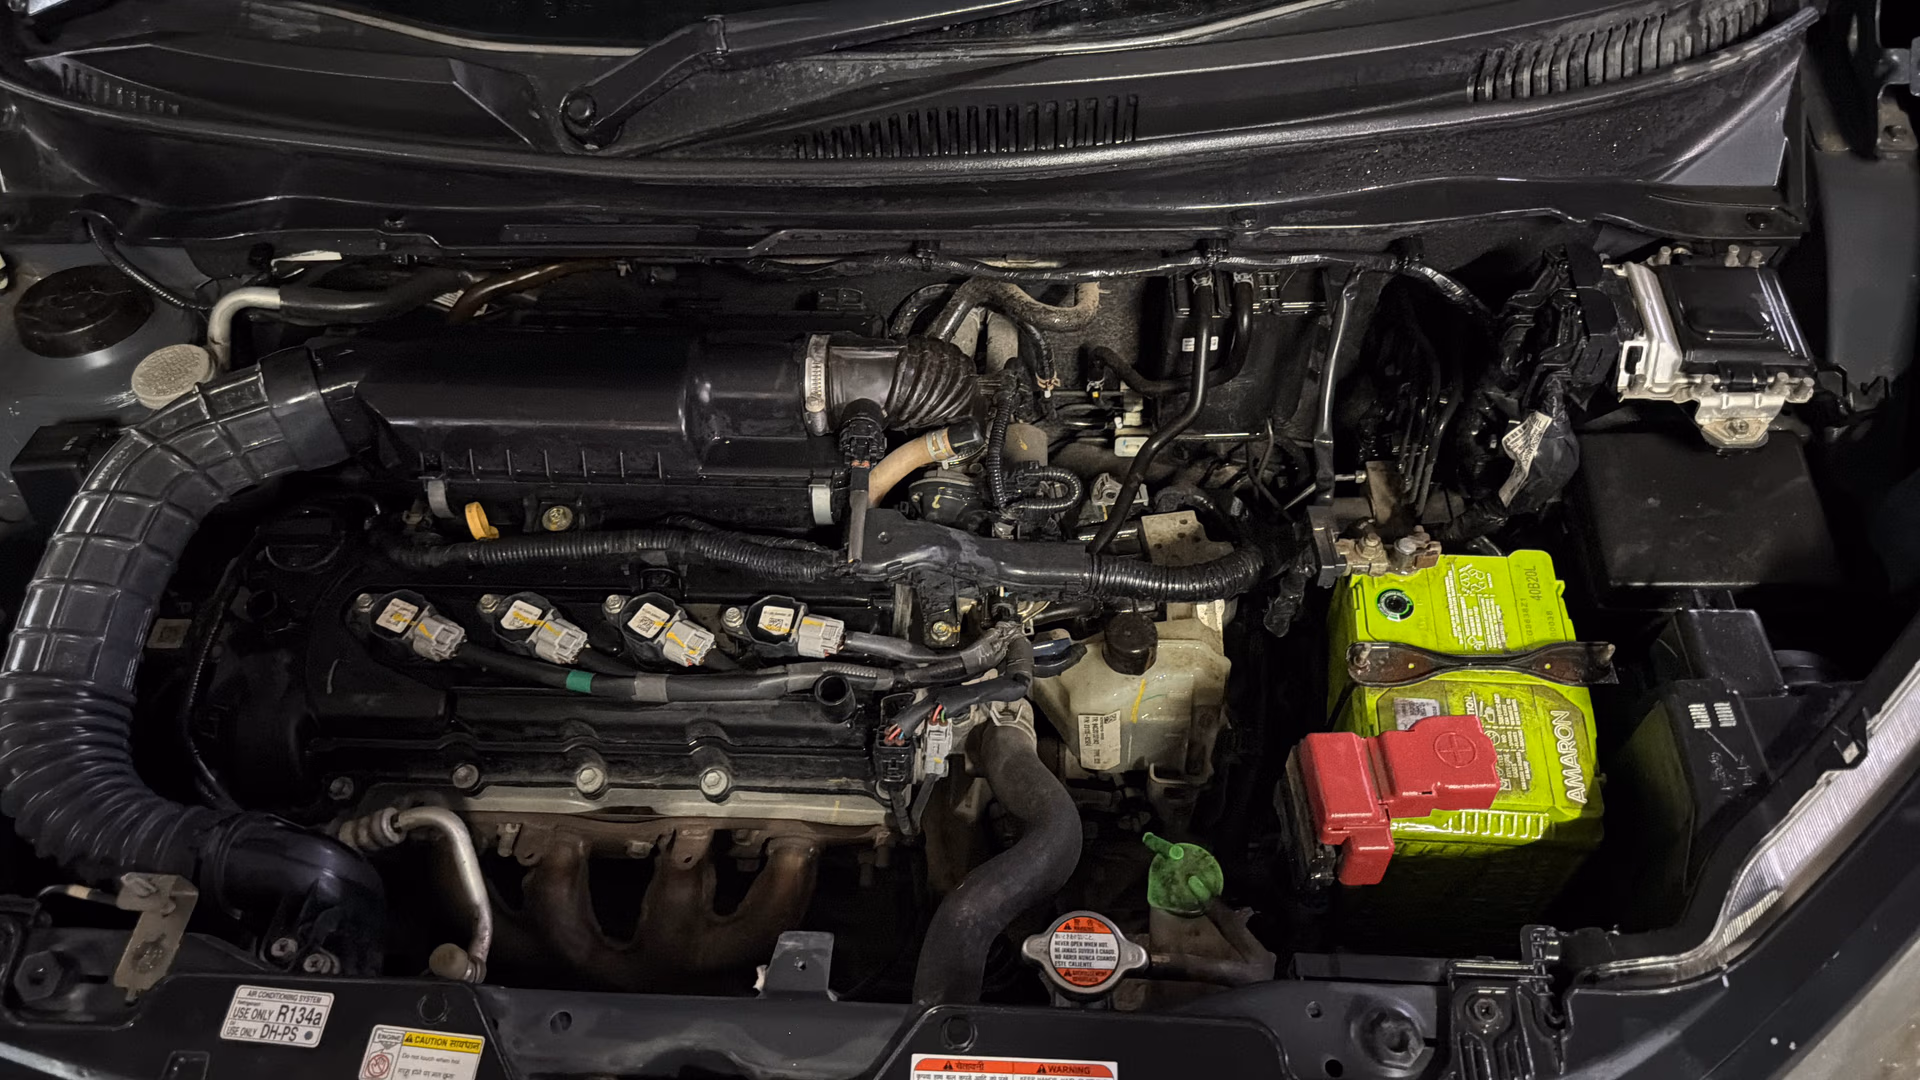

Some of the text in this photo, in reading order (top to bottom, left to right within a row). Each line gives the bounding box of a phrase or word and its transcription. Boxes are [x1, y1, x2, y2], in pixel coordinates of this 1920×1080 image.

[1524, 565, 1542, 601] 40B20L
[1464, 696, 1475, 715] TION
[1550, 710, 1588, 804] AMARON
[257, 991, 298, 1001] CONDITIONING
[299, 995, 322, 1003] SYSTEM
[233, 1004, 322, 1025] USE ONLY R134a
[226, 1024, 299, 1042] USE ONLY DH-PS
[377, 1033, 401, 1041] ENGINE
[414, 1037, 448, 1047] CAUTION
[1049, 1066, 1091, 1074] WARNING
